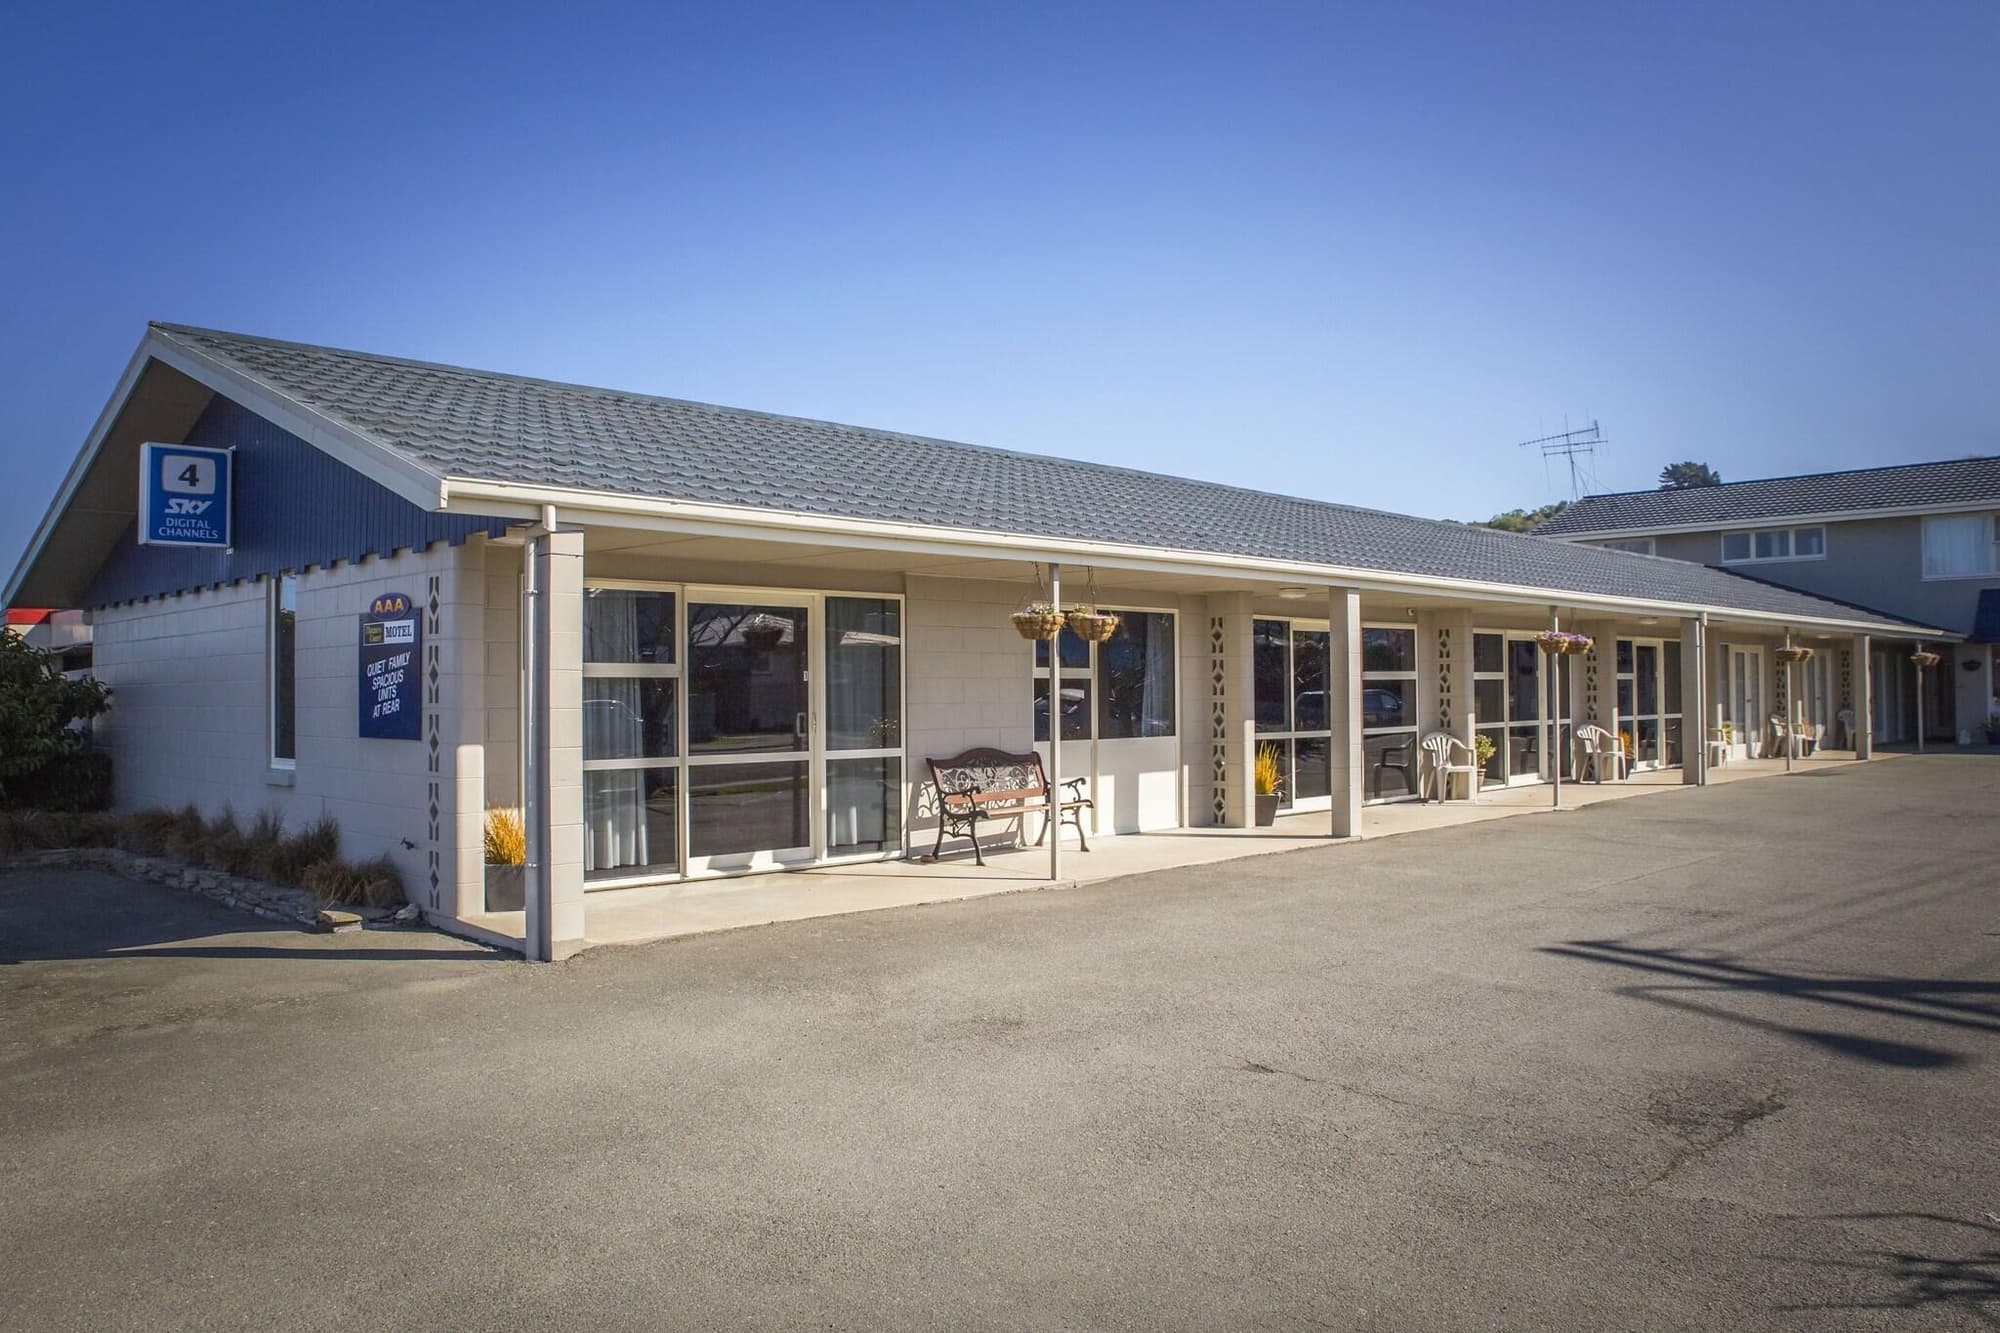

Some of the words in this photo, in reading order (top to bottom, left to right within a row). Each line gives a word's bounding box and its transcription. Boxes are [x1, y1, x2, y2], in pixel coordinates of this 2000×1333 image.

[178, 464, 199, 487] 4
[164, 498, 212, 515] SKY
[166, 517, 210, 529] DIGITAL
[158, 527, 218, 539] CHANNELS
[385, 625, 412, 638] MOTEL
[367, 660, 386, 677] QUIET
[388, 651, 411, 670] FAMILY
[372, 669, 404, 690] SPACIOUS
[378, 685, 397, 702] UNITS
[372, 704, 382, 718] AT
[382, 699, 400, 715] REAR
